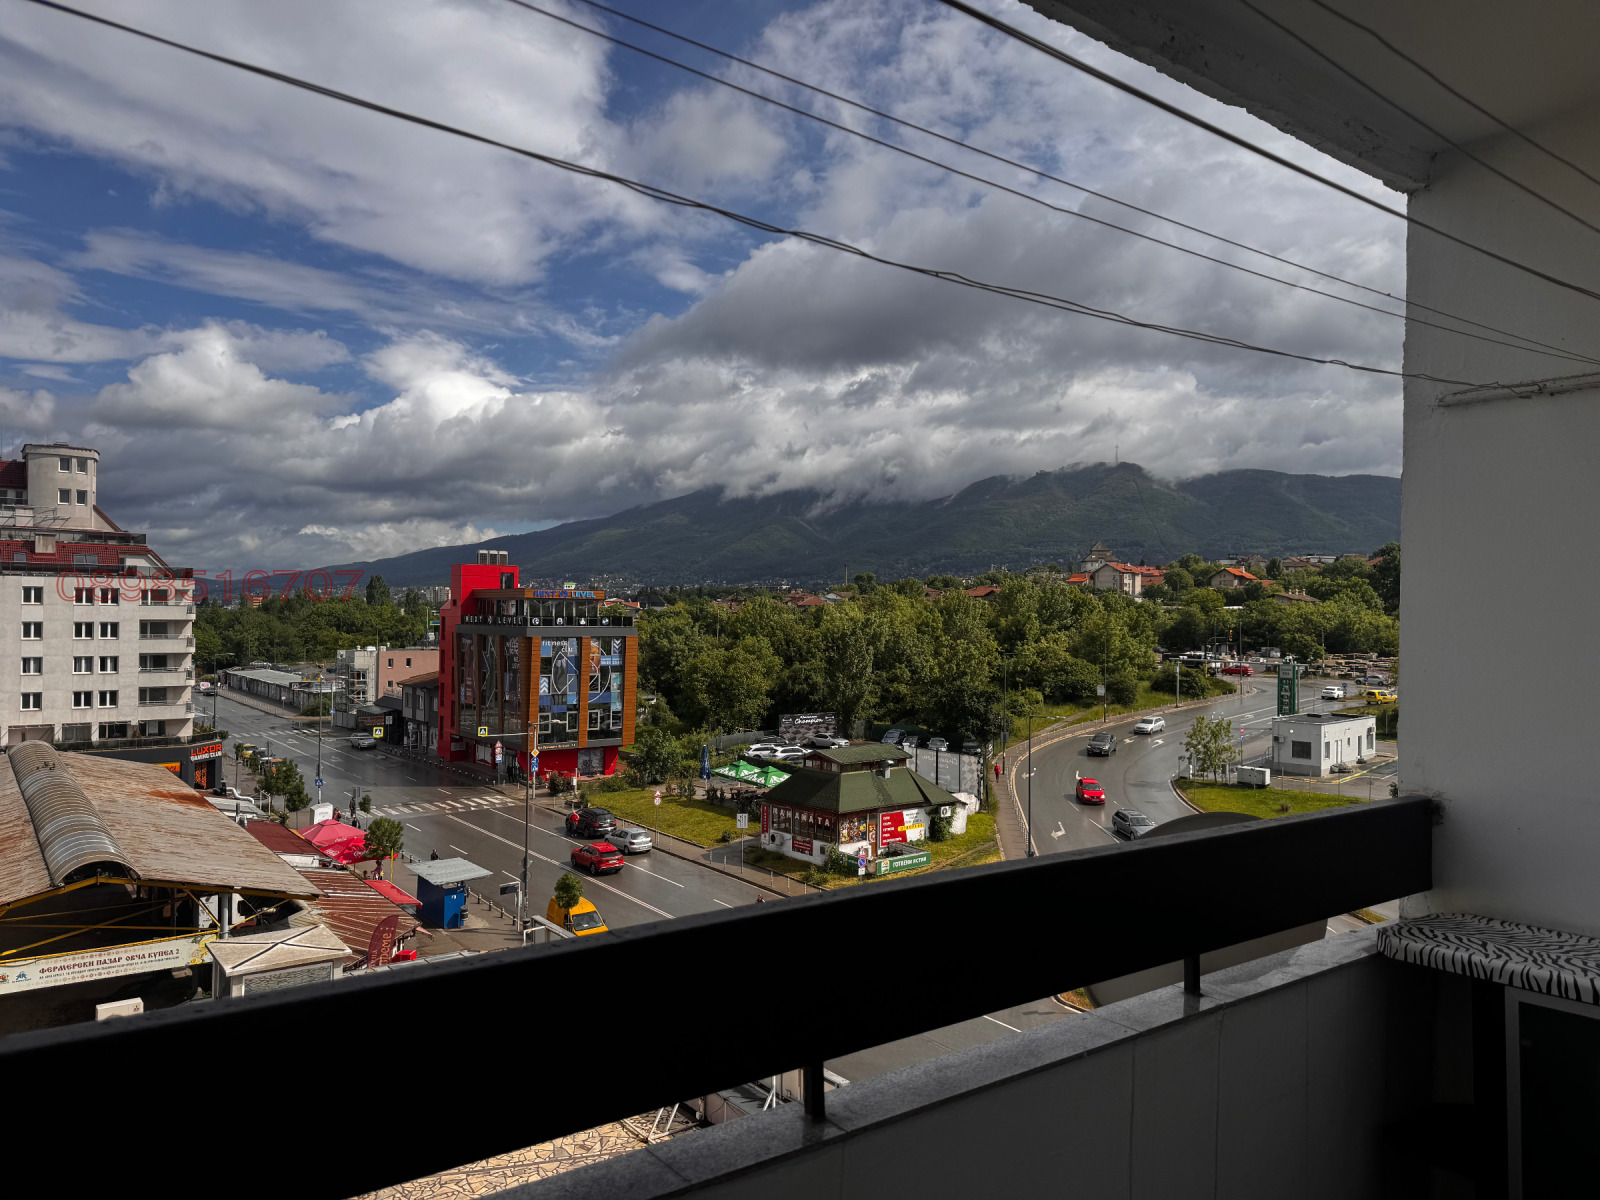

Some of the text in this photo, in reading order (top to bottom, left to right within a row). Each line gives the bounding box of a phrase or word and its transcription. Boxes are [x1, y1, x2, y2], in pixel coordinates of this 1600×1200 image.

[534, 590, 596, 599] NEXT LEVEL
[498, 616, 522, 625] LEVEL
[190, 743, 222, 756] LUXOR
[39, 960, 94, 974] ФЕРМЕРСКИ
[96, 956, 123, 966] ПАЗАР
[125, 953, 146, 962] ОВЧА
[147, 949, 174, 959] КУПЕЛ
